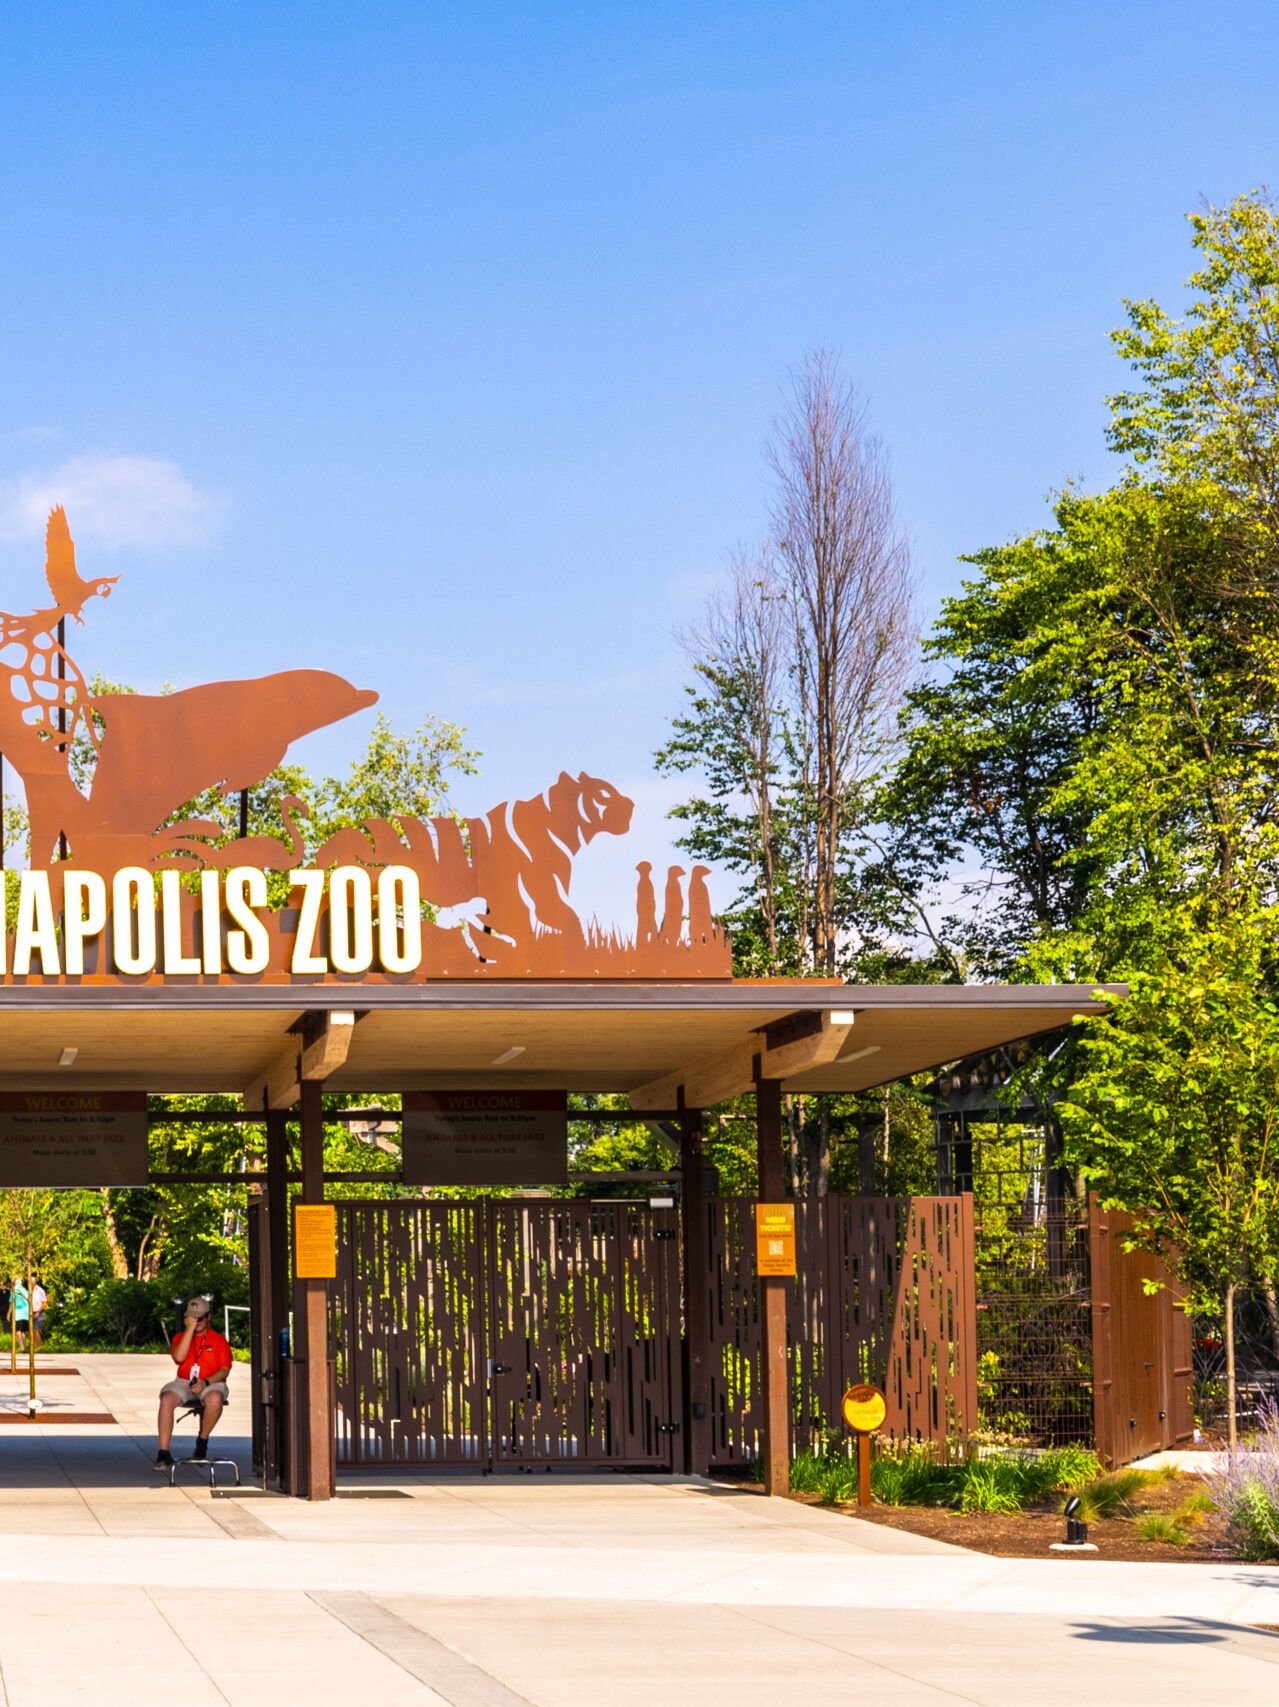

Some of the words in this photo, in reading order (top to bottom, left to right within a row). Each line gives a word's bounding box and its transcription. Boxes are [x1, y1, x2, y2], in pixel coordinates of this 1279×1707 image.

[288, 864, 422, 976] ZOO
[25, 1096, 102, 1110] WELCOME
[448, 1096, 522, 1109] WELCOME
[3, 1134, 47, 1144] ANIMALS
[58, 1134, 75, 1144] ALL
[77, 1134, 100, 1144] THAT
[103, 1134, 124, 1144] JAZZ
[425, 1133, 468, 1142] ANIMALS
[479, 1133, 496, 1142] ALL
[497, 1133, 521, 1142] THAT
[523, 1133, 544, 1142] JAZZ
